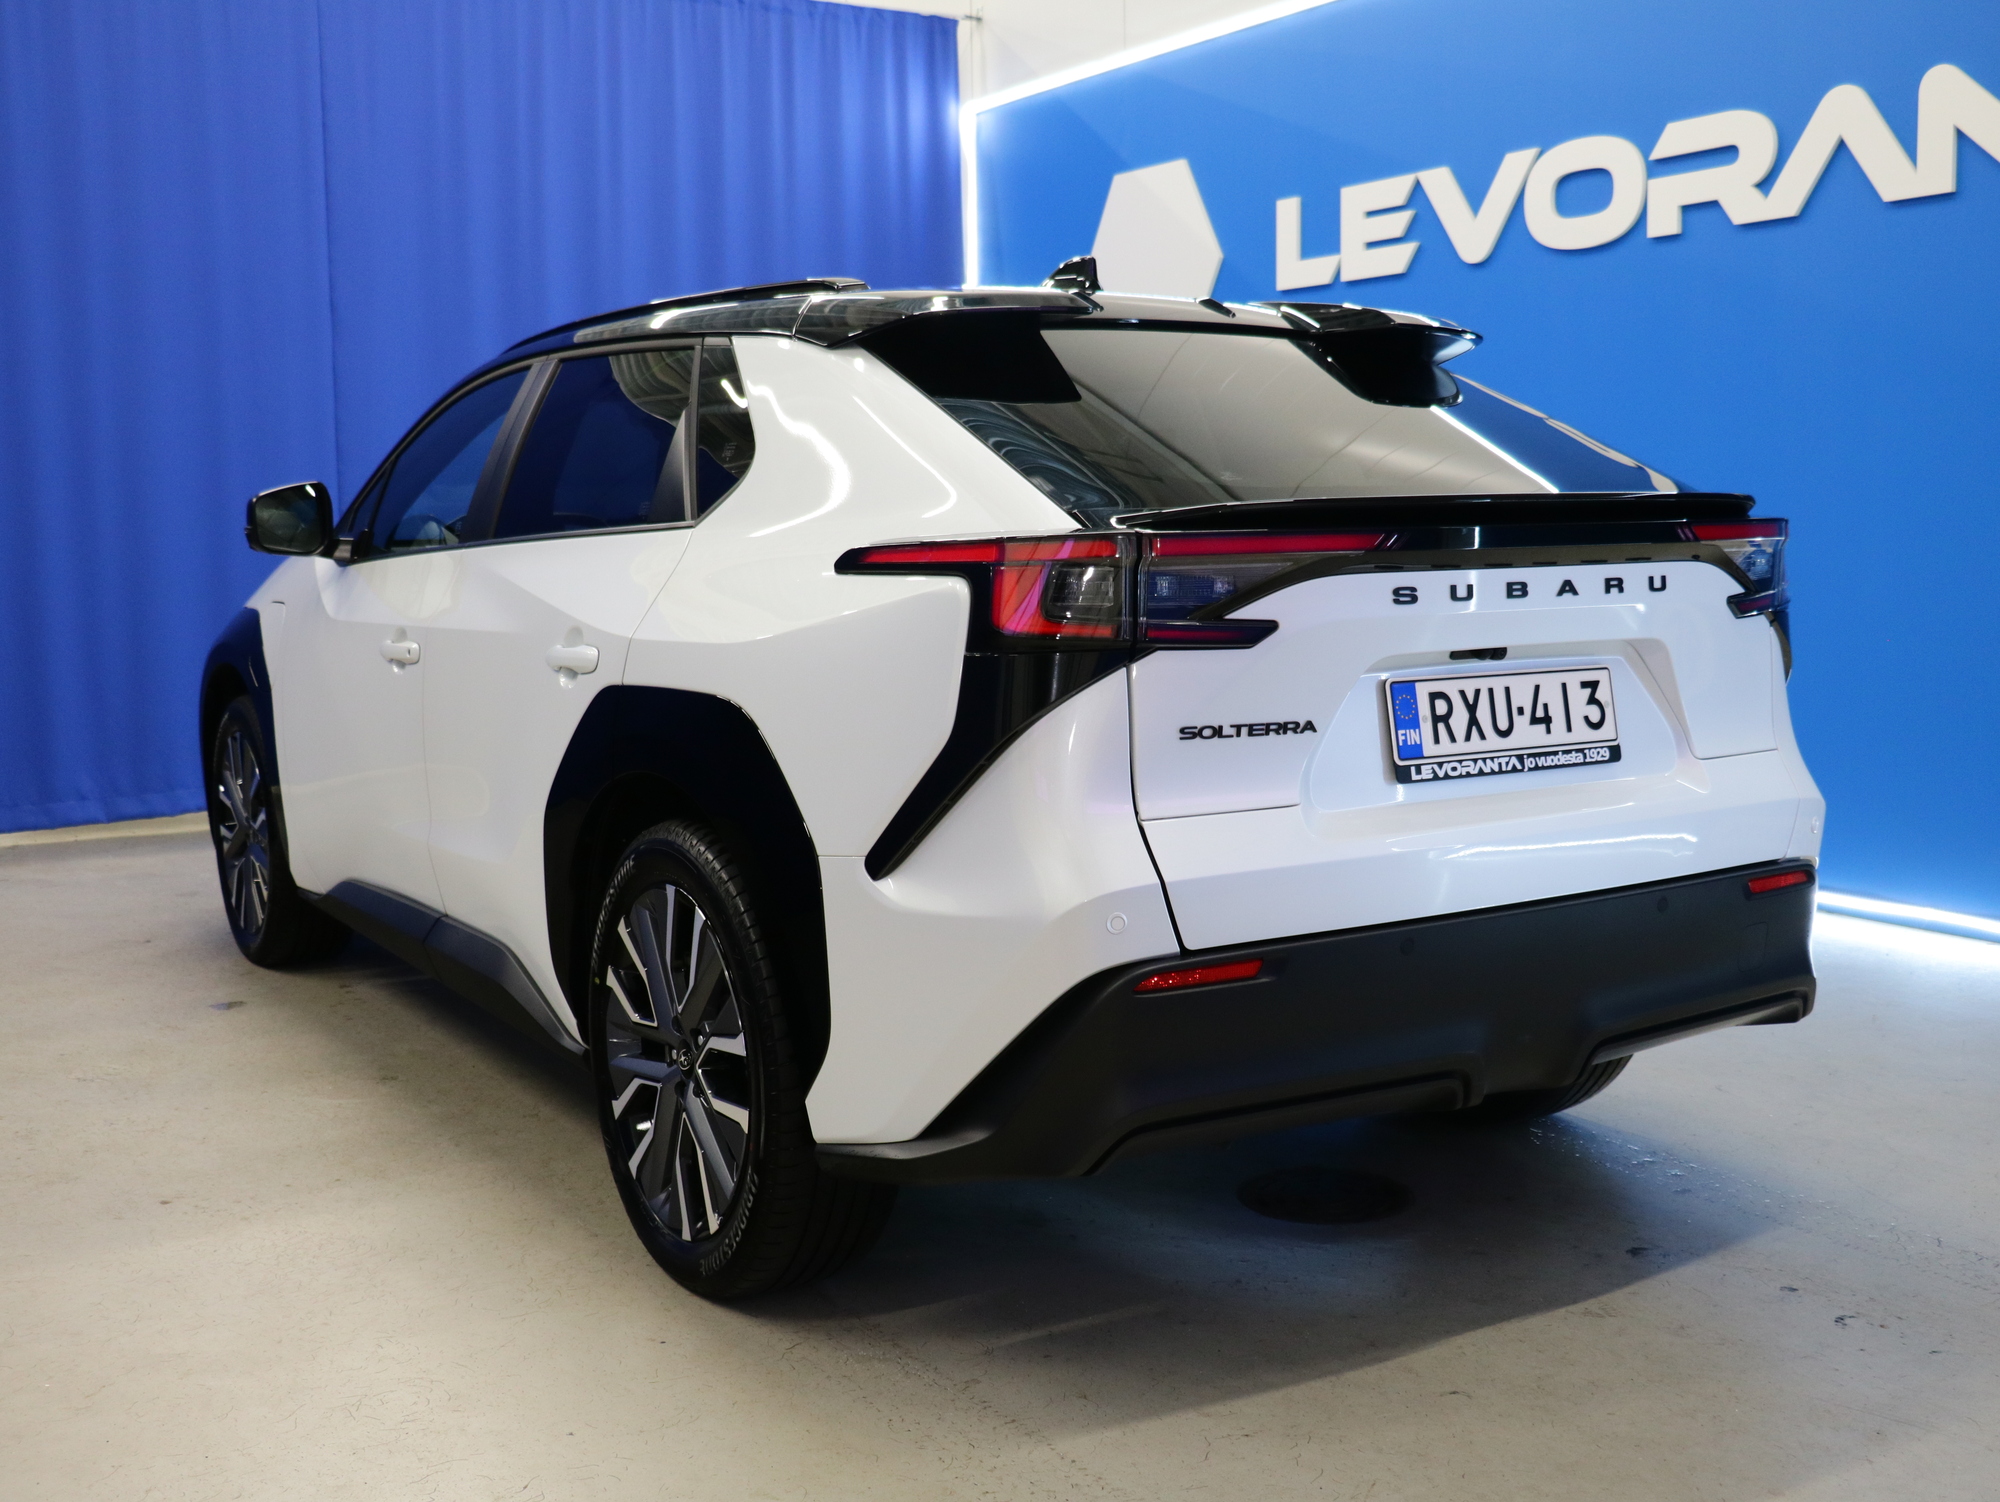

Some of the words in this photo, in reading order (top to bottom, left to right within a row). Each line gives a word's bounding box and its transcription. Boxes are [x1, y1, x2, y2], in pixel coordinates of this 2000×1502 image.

[1392, 575, 1668, 605] SUBARU
[1179, 720, 1318, 741] SOLTERRA
[1398, 728, 1421, 746] FIN
[1410, 756, 1521, 781] LEVORANTA
[1523, 756, 1535, 772] jo
[1536, 751, 1584, 768] vuodesta
[1584, 747, 1610, 762] 1929
